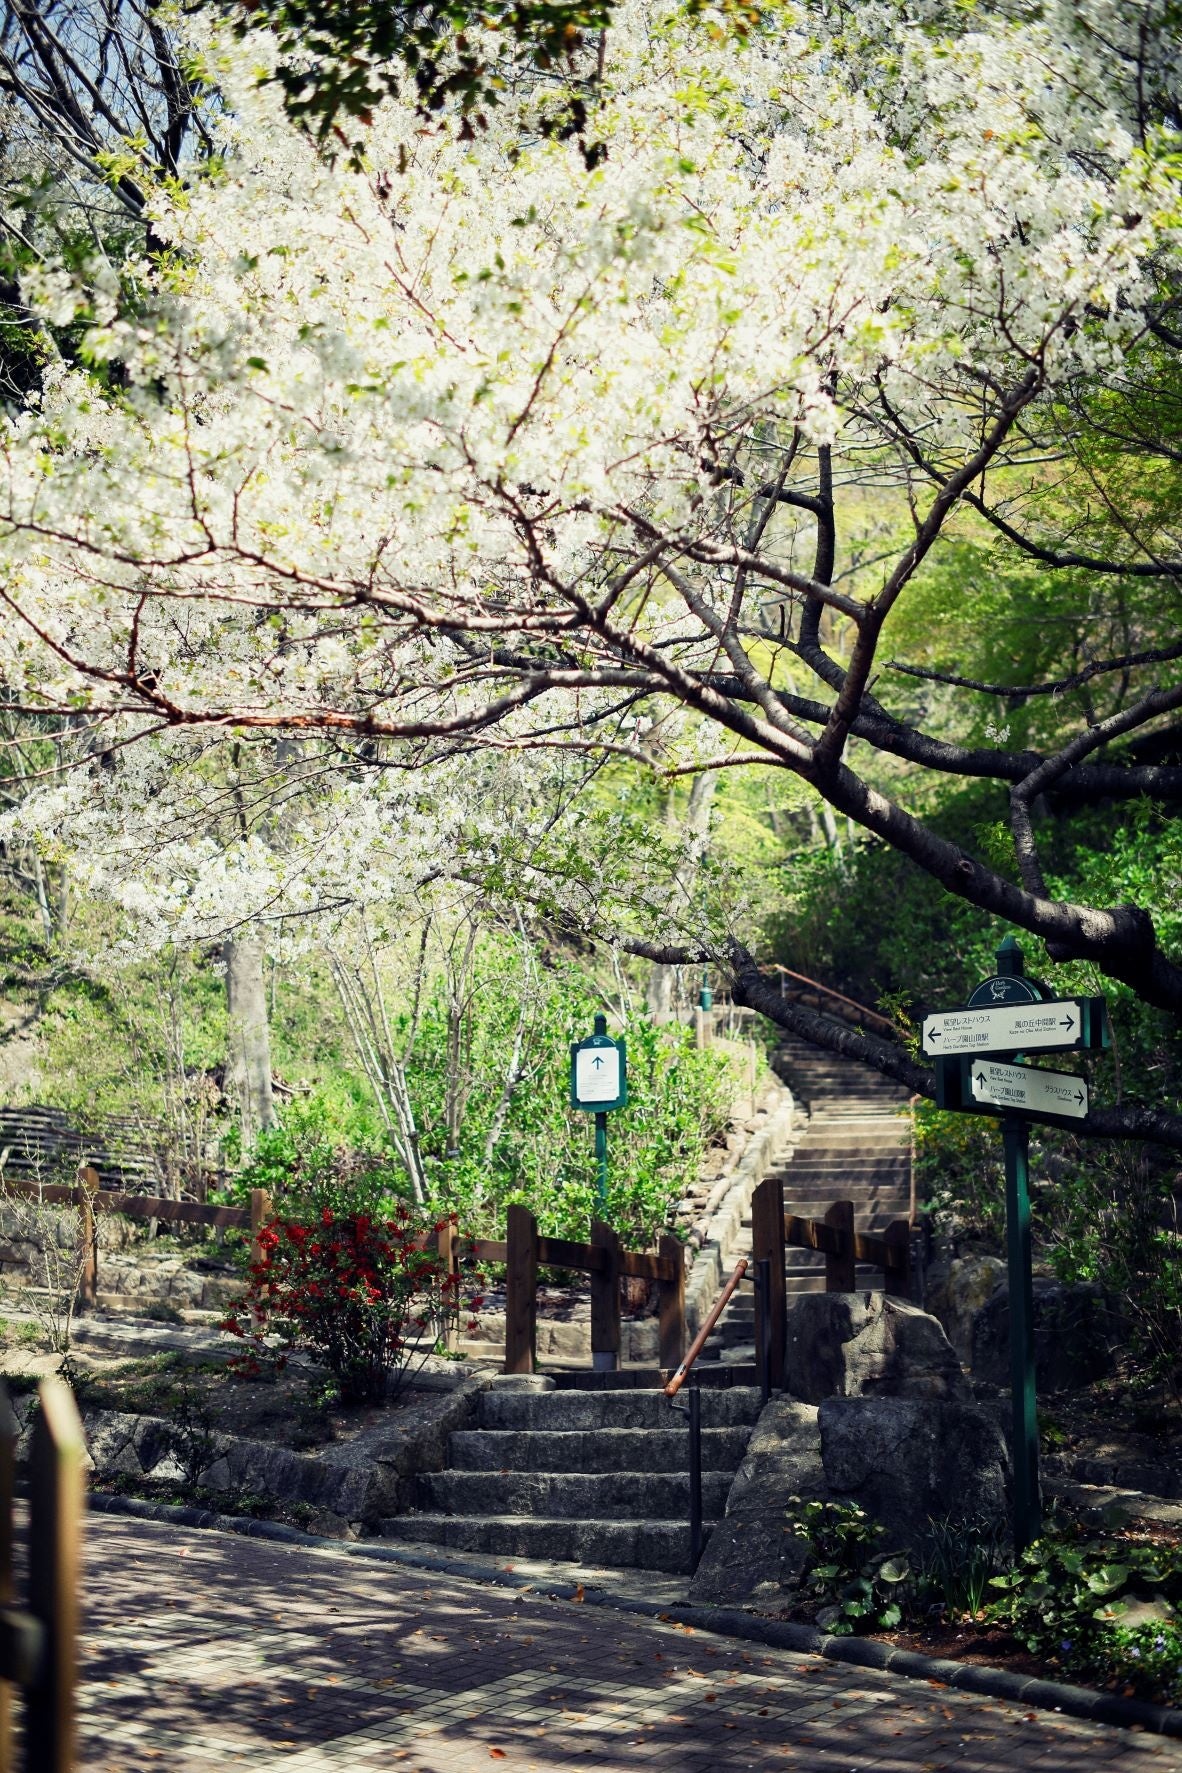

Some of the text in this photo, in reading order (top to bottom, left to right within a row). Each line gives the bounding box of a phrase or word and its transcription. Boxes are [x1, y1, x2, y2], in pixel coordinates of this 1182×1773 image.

[943, 1015, 991, 1027] 展望レストハウス
[1015, 1017, 1057, 1029] 風の丘中間駅
